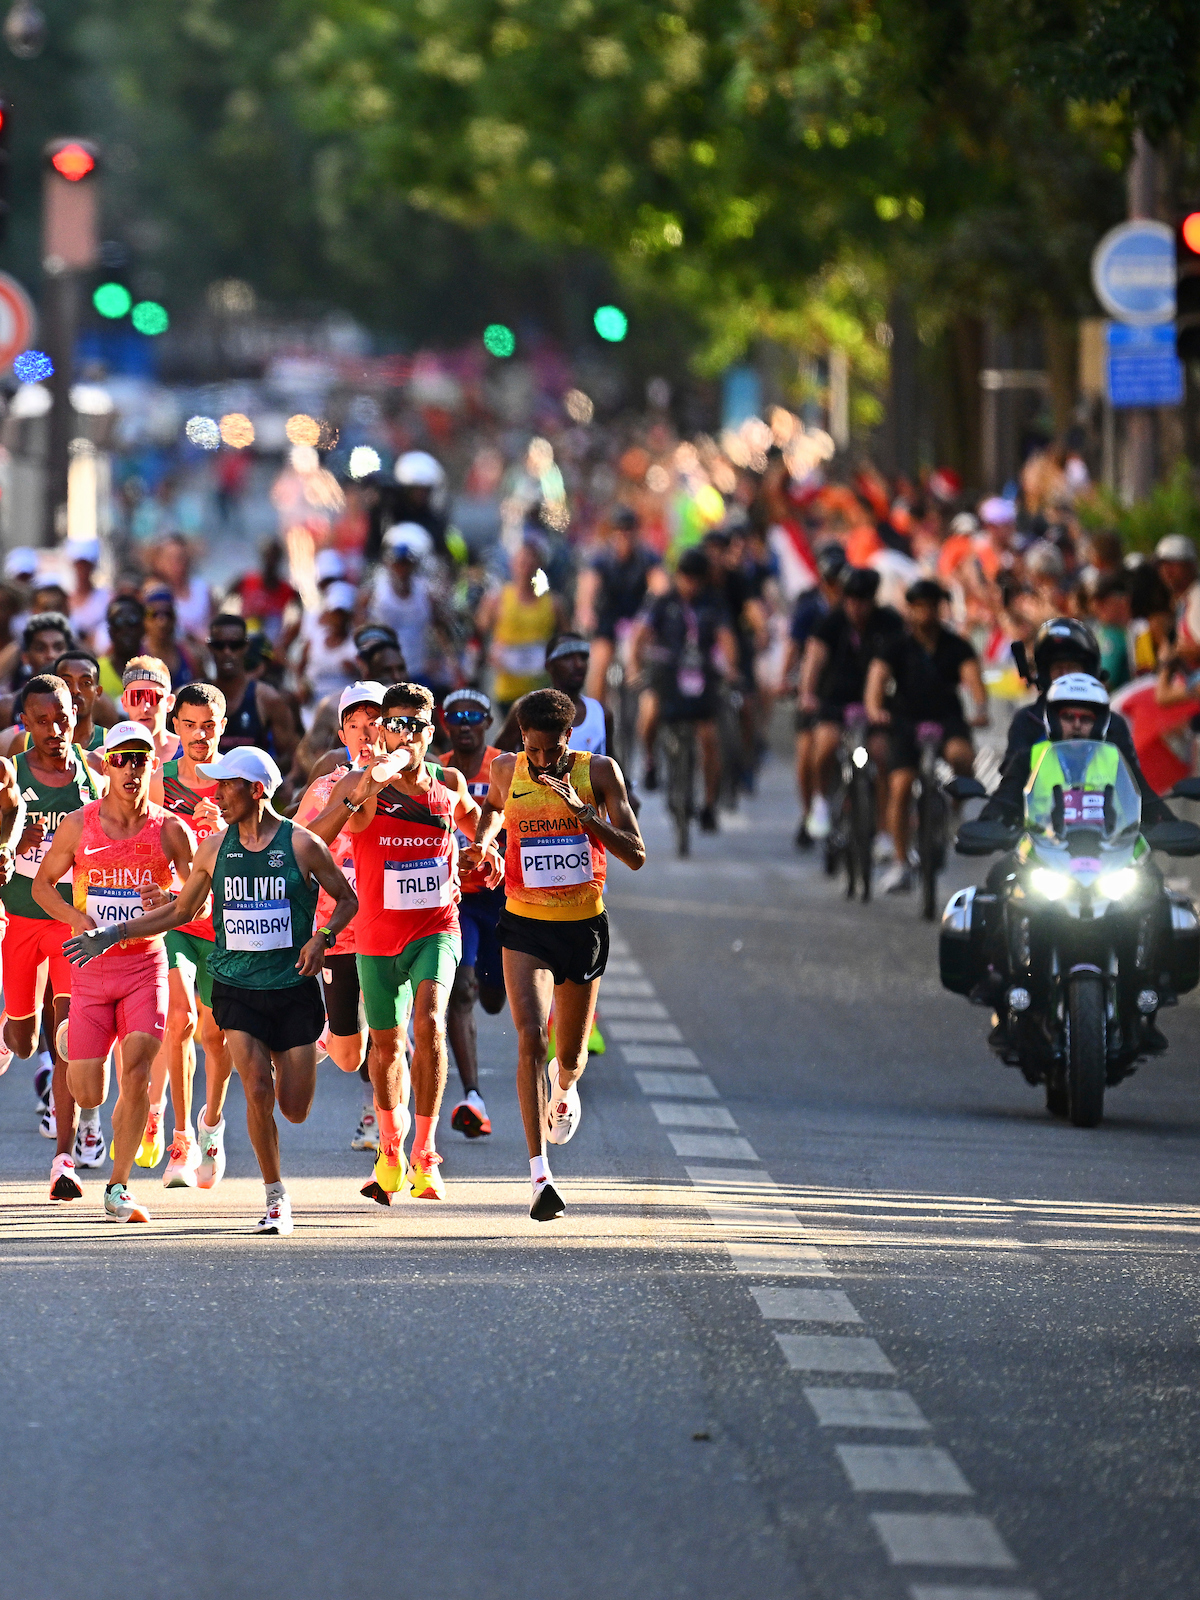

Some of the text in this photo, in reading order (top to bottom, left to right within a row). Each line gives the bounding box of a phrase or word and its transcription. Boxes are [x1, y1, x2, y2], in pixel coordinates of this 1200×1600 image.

[519, 817, 579, 833] GERMAN
[378, 836, 449, 847] MOROCCO
[524, 851, 590, 872] PETROS
[87, 867, 153, 886] CHINA
[397, 875, 440, 894] TALBI
[224, 876, 286, 901] BOLIVIA
[225, 916, 290, 935] GARIBAY
